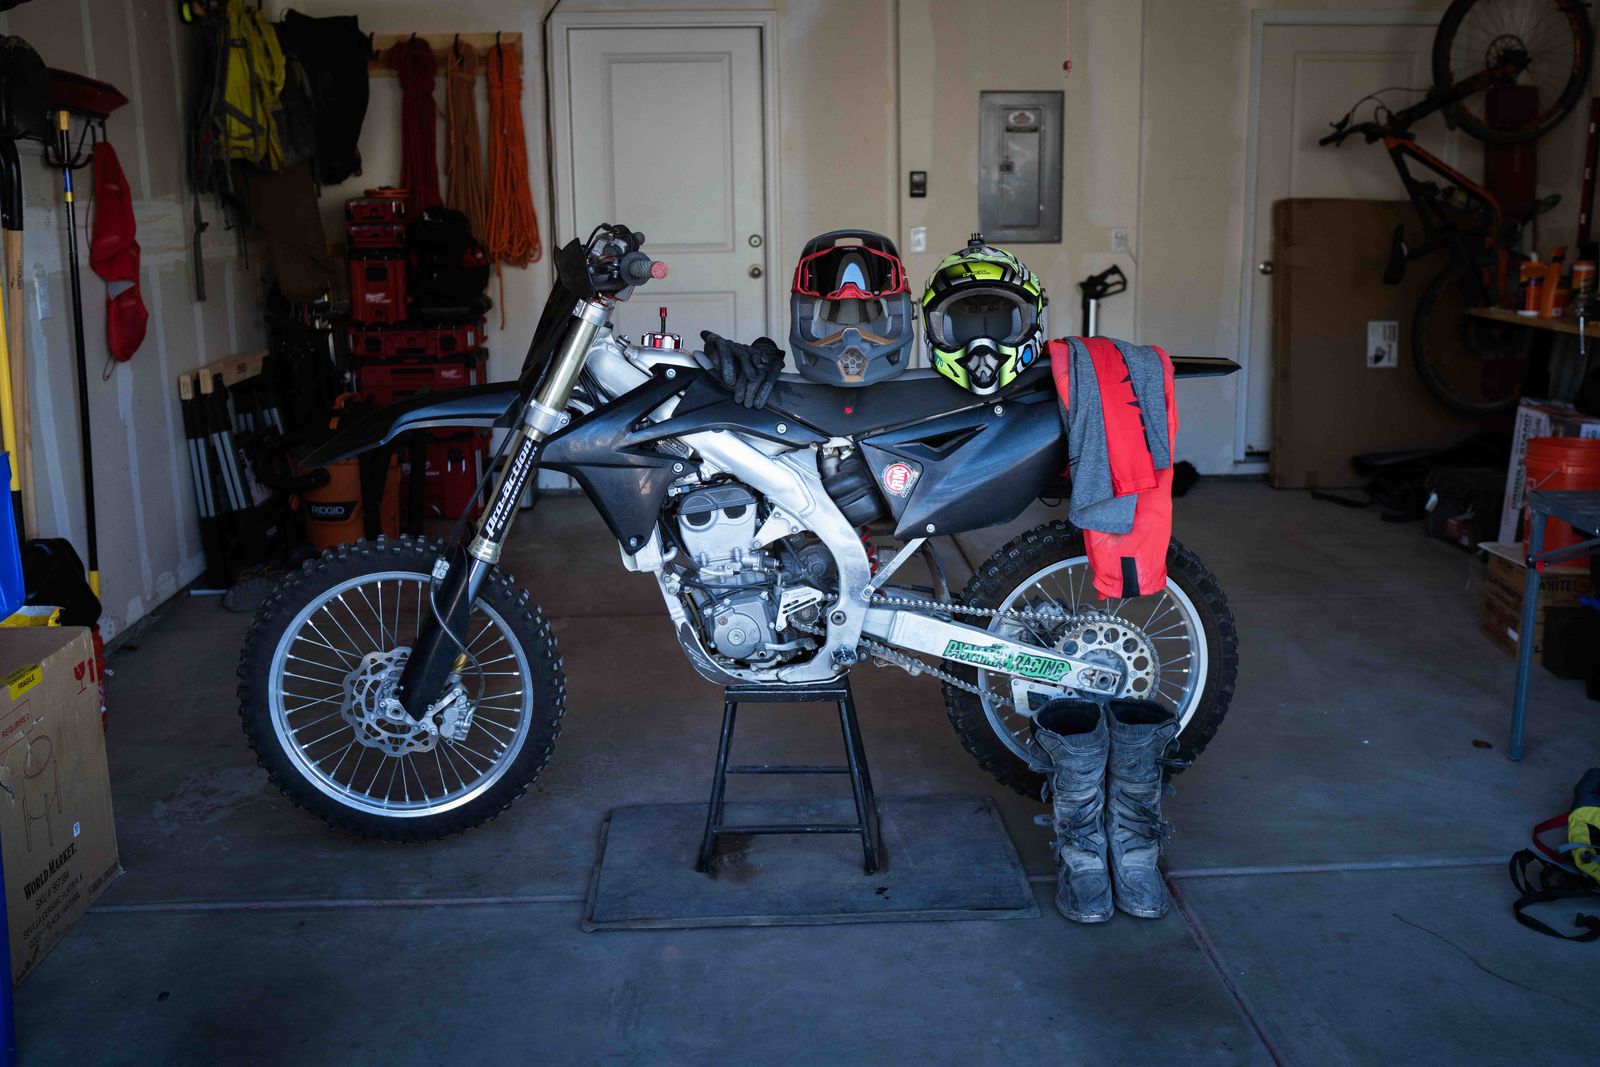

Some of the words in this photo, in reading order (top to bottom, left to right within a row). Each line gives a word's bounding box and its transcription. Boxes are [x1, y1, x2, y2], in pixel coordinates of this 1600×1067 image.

[485, 439, 532, 538] pro-action
[311, 505, 345, 515] RIDGID
[17, 674, 35, 691] FRAGILE
